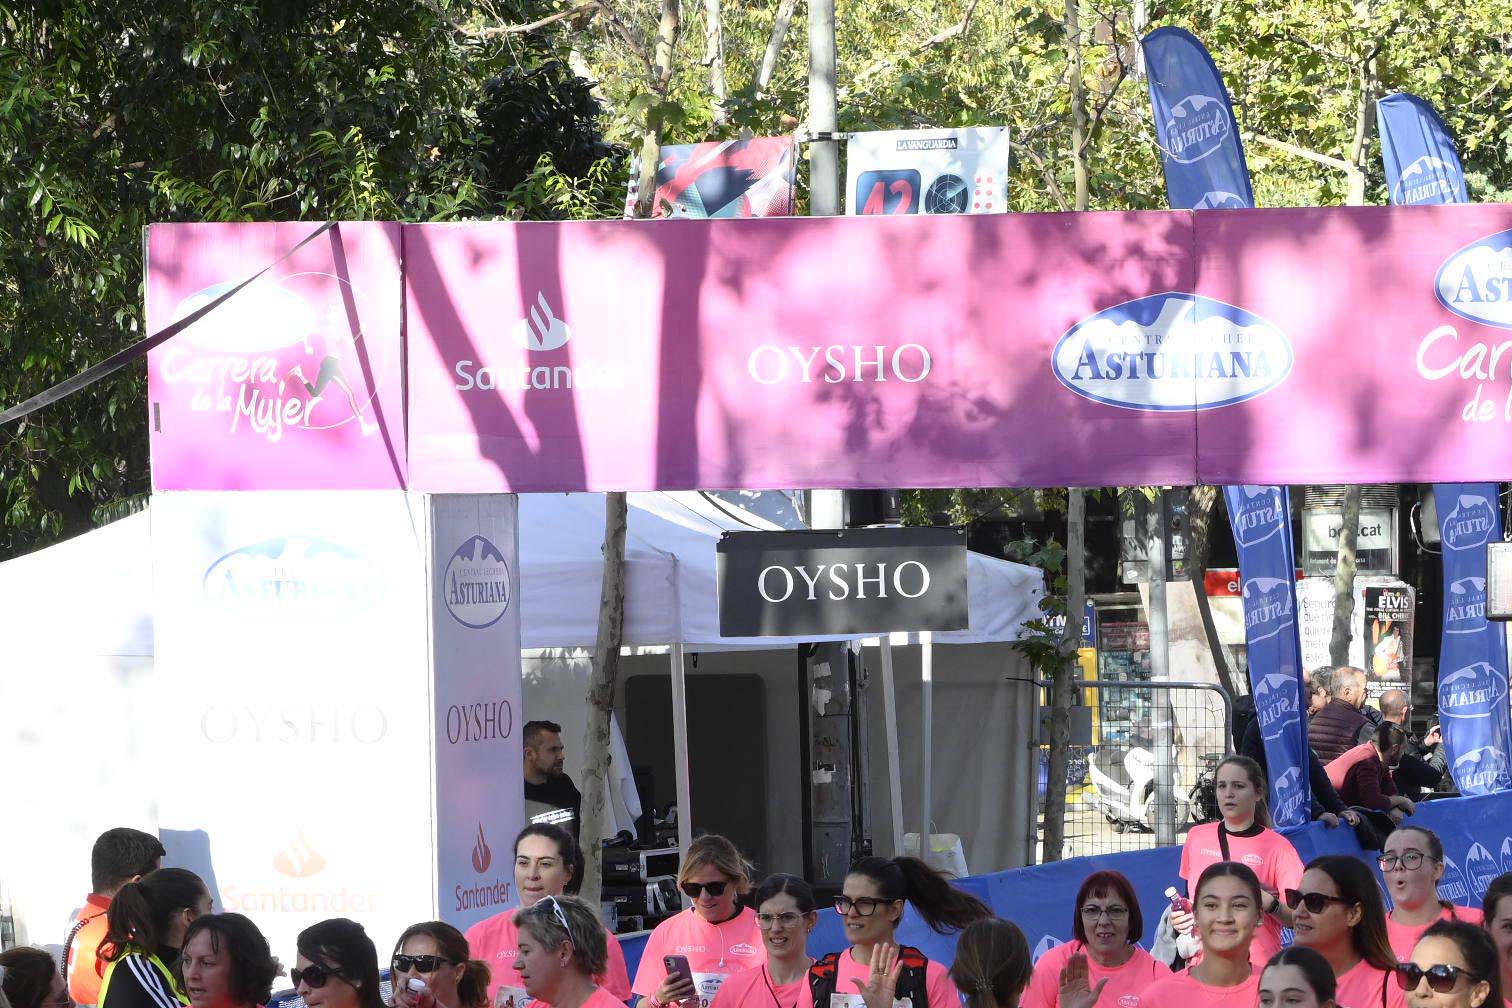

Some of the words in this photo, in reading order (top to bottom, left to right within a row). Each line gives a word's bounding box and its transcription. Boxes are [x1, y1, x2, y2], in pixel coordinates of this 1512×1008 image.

[747, 343, 932, 384] OYSHO
[1070, 338, 1272, 381] ASTURIANA
[229, 383, 323, 442] Mujer
[1462, 383, 1494, 422] de
[450, 572, 507, 607] ASTURIANA
[758, 561, 931, 603] OYSHO
[1378, 596, 1409, 609] ELVIS
[446, 700, 512, 746] OYSHO
[456, 879, 512, 913] Santander
